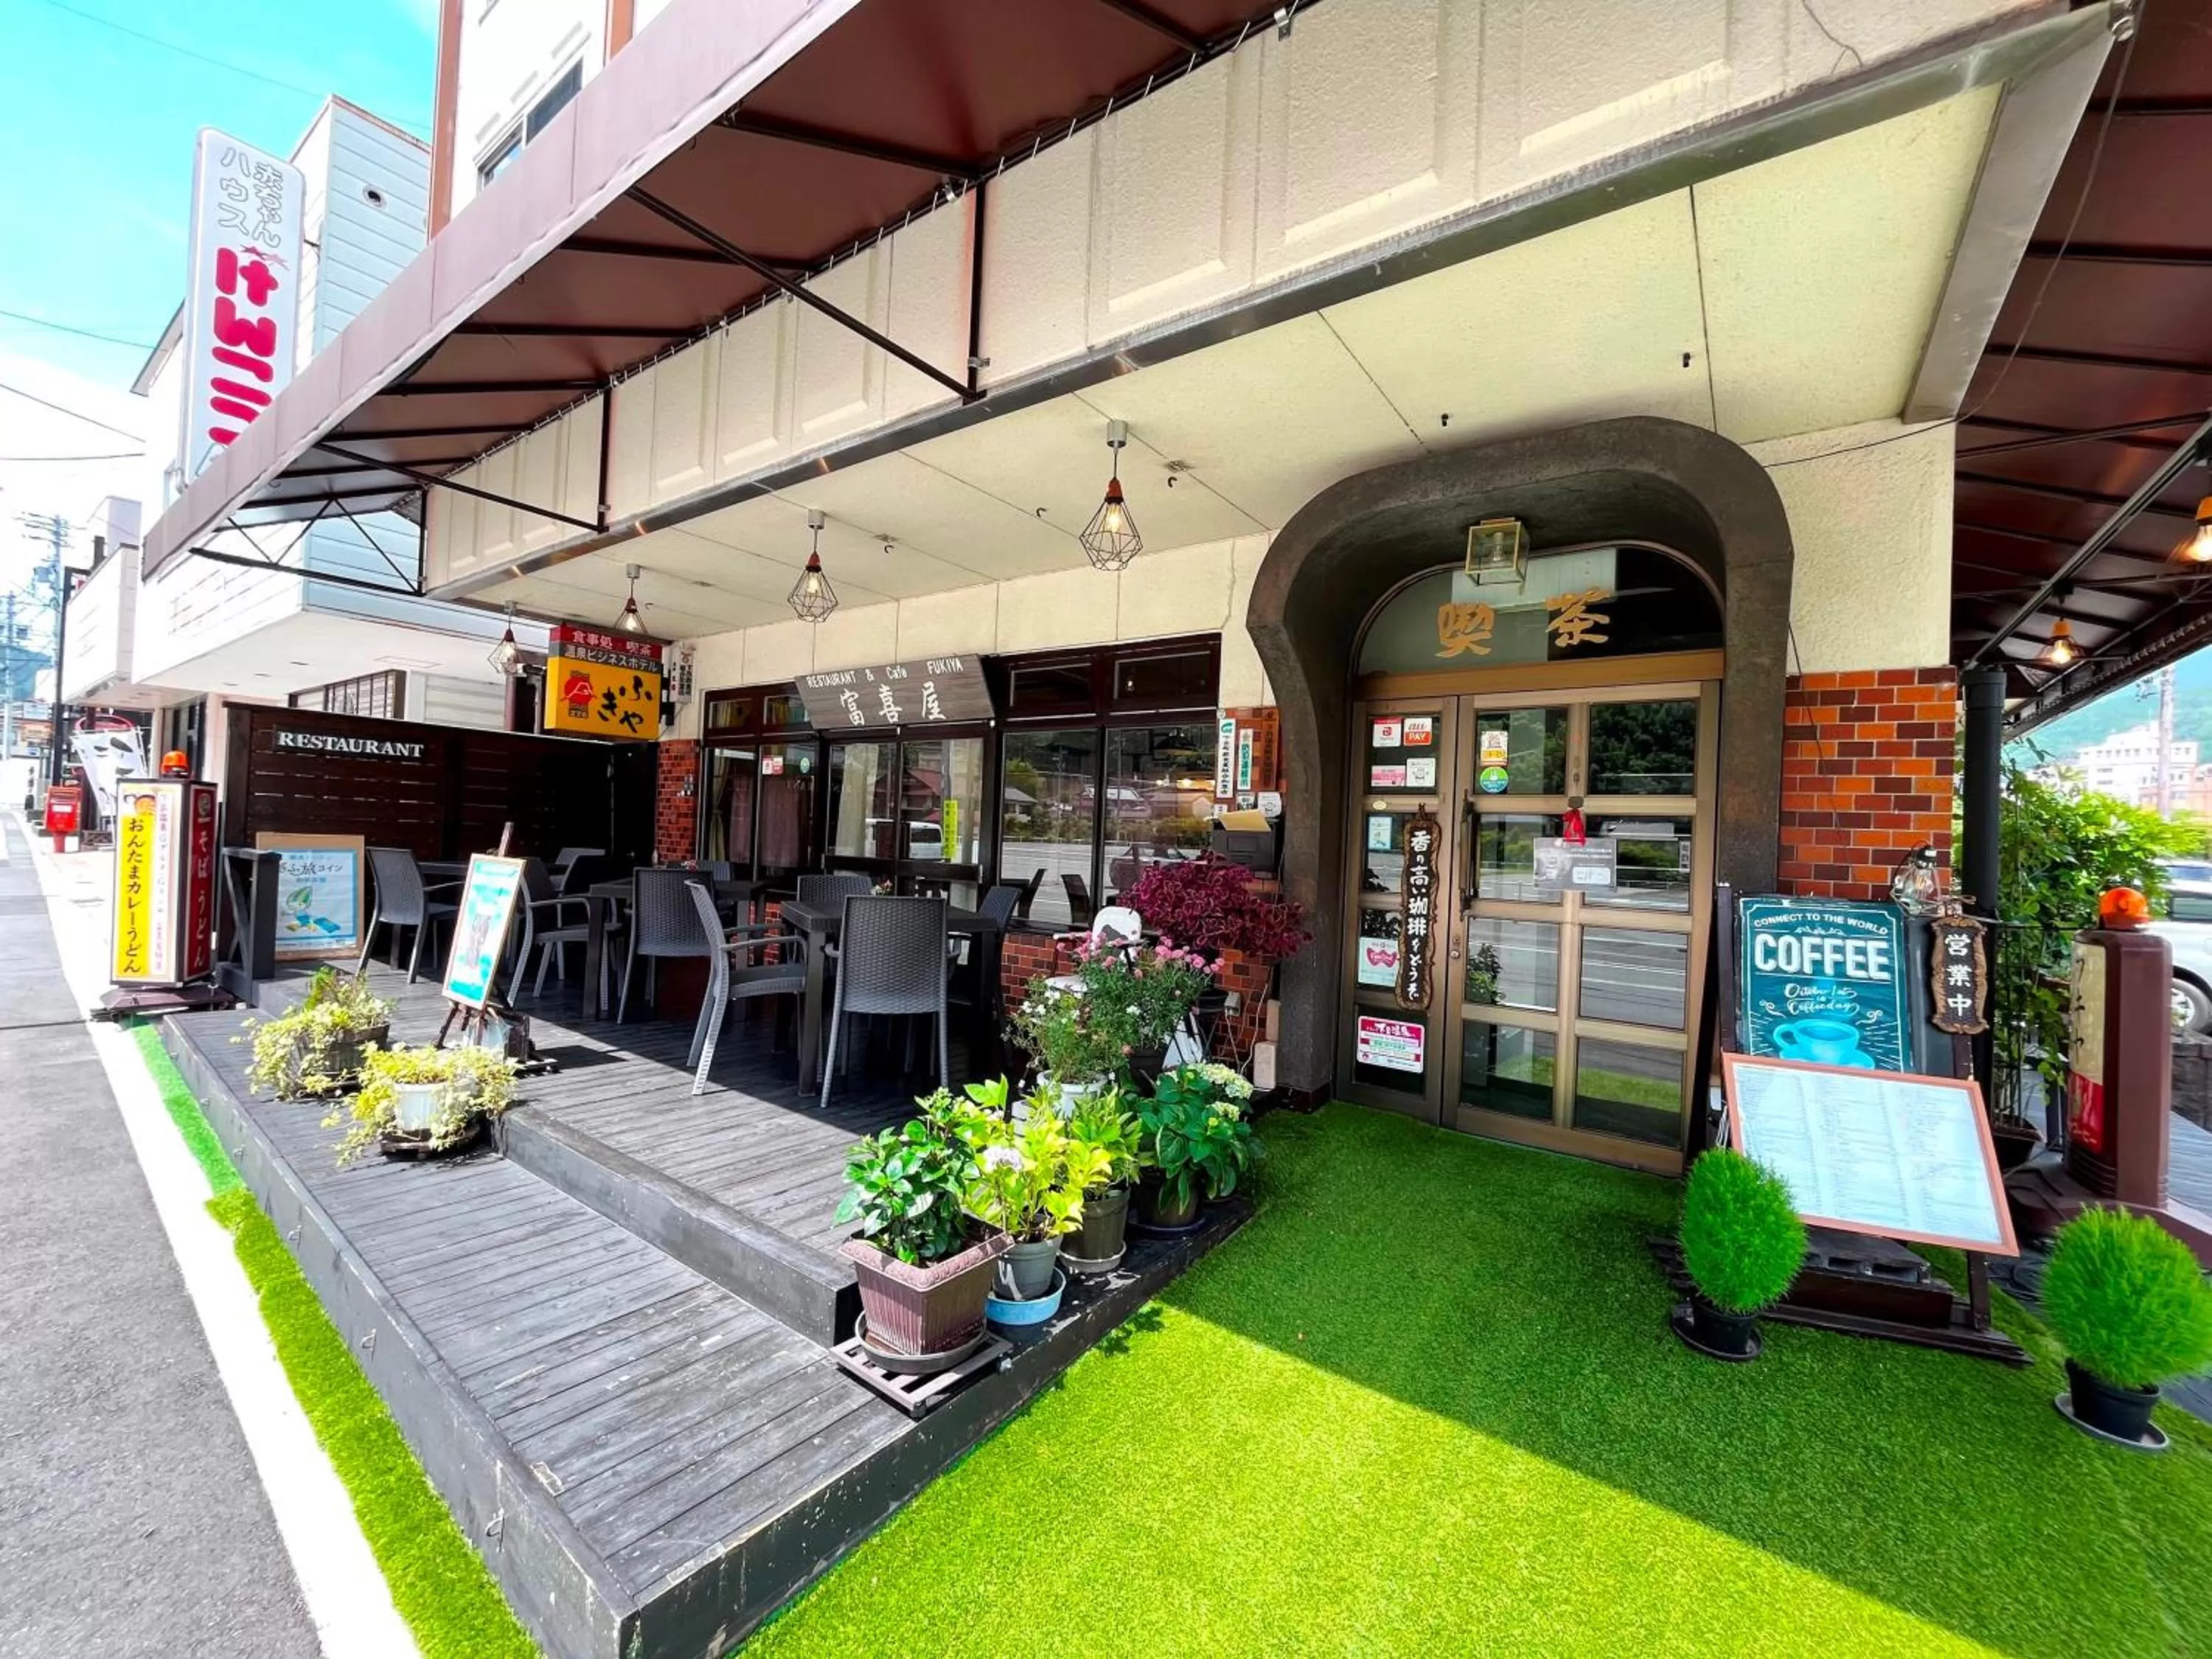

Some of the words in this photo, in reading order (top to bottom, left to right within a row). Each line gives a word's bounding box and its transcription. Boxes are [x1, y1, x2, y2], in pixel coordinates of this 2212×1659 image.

[217, 147, 251, 237] ハウス
[572, 630, 613, 650] 食事処
[1435, 585, 1615, 658] 喫茶
[806, 670, 856, 689] RESTAURANT
[866, 669, 874, 681] &
[886, 665, 908, 680] Cafe
[927, 657, 964, 675] FUKIYA
[277, 731, 425, 757] RESTAURANT
[1409, 732, 1426, 741] PAY
[198, 831, 210, 879] そば
[124, 818, 145, 973] おんたまカレーうどん
[1408, 830, 1432, 1001] 香り高い珈琲をどうぞ
[194, 890, 207, 969] うどん
[1754, 914, 1803, 927] CONNECT
[1806, 913, 1820, 921] TO
[1824, 914, 1844, 924] THE
[1847, 917, 1888, 935] WORLD
[1754, 933, 1891, 980] COFFEE
[1944, 933, 1974, 1017] 営業中
